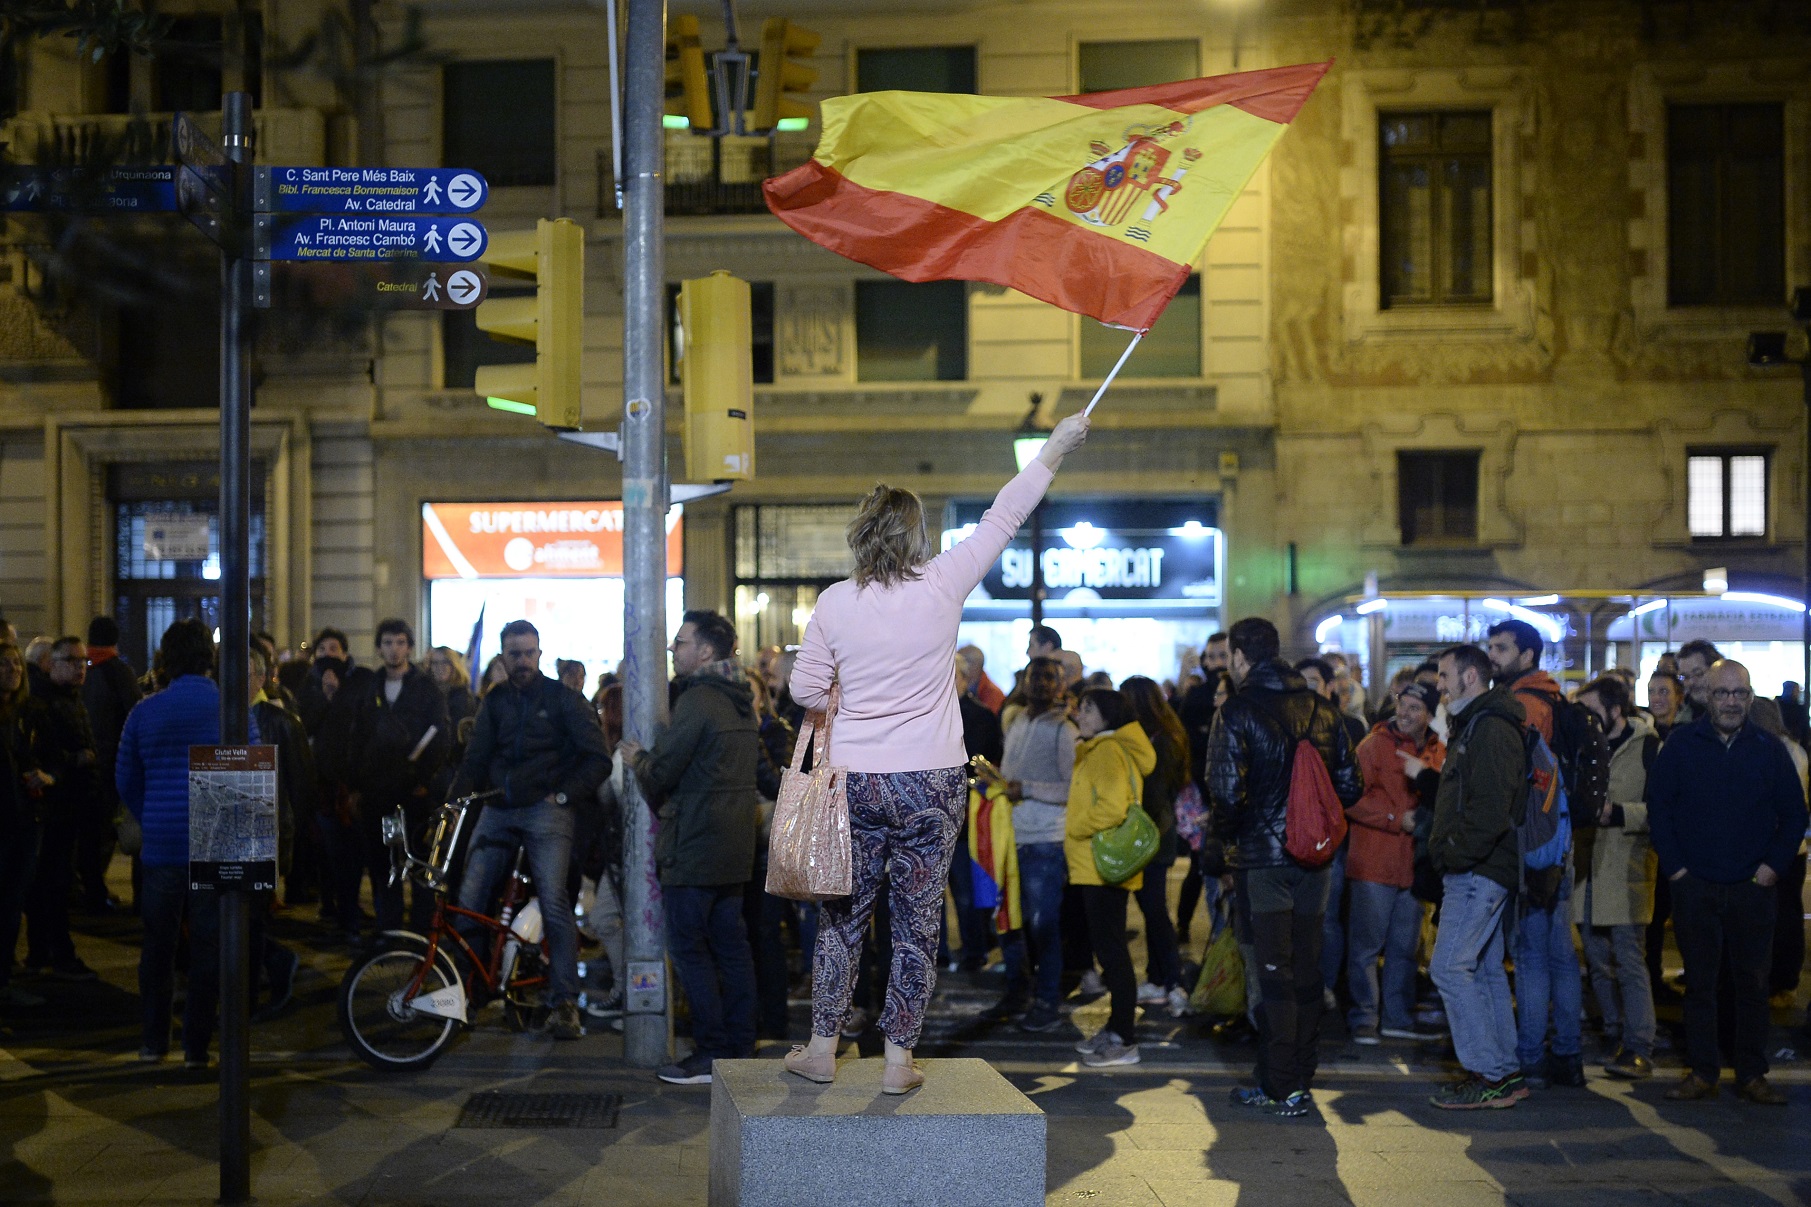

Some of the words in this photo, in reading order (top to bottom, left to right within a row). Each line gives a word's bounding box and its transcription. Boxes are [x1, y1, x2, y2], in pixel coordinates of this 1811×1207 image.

[286, 169, 299, 182] C.
[302, 169, 330, 182] Sant
[332, 169, 360, 182] Pere
[362, 169, 387, 182] Més
[390, 169, 415, 182] Baix
[278, 184, 299, 195] Bibl.
[301, 184, 352, 195] Francesca
[353, 185, 419, 195] Bonnemaison
[344, 198, 362, 210] Av.
[366, 198, 416, 210] Catedral
[320, 218, 335, 231] Pl.
[337, 218, 375, 231] Antoni
[378, 219, 416, 231] Maura
[294, 232, 312, 244] Av.
[316, 232, 370, 245] Francesc
[372, 233, 416, 245] Cambó
[297, 247, 332, 257] Mercat
[333, 247, 346, 257] de
[348, 247, 376, 258] Santa
[377, 248, 418, 258] Caterina
[376, 281, 418, 292] Catedral
[1001, 547, 1165, 589] SUERMERCAT
[233, 748, 248, 756] Vella
